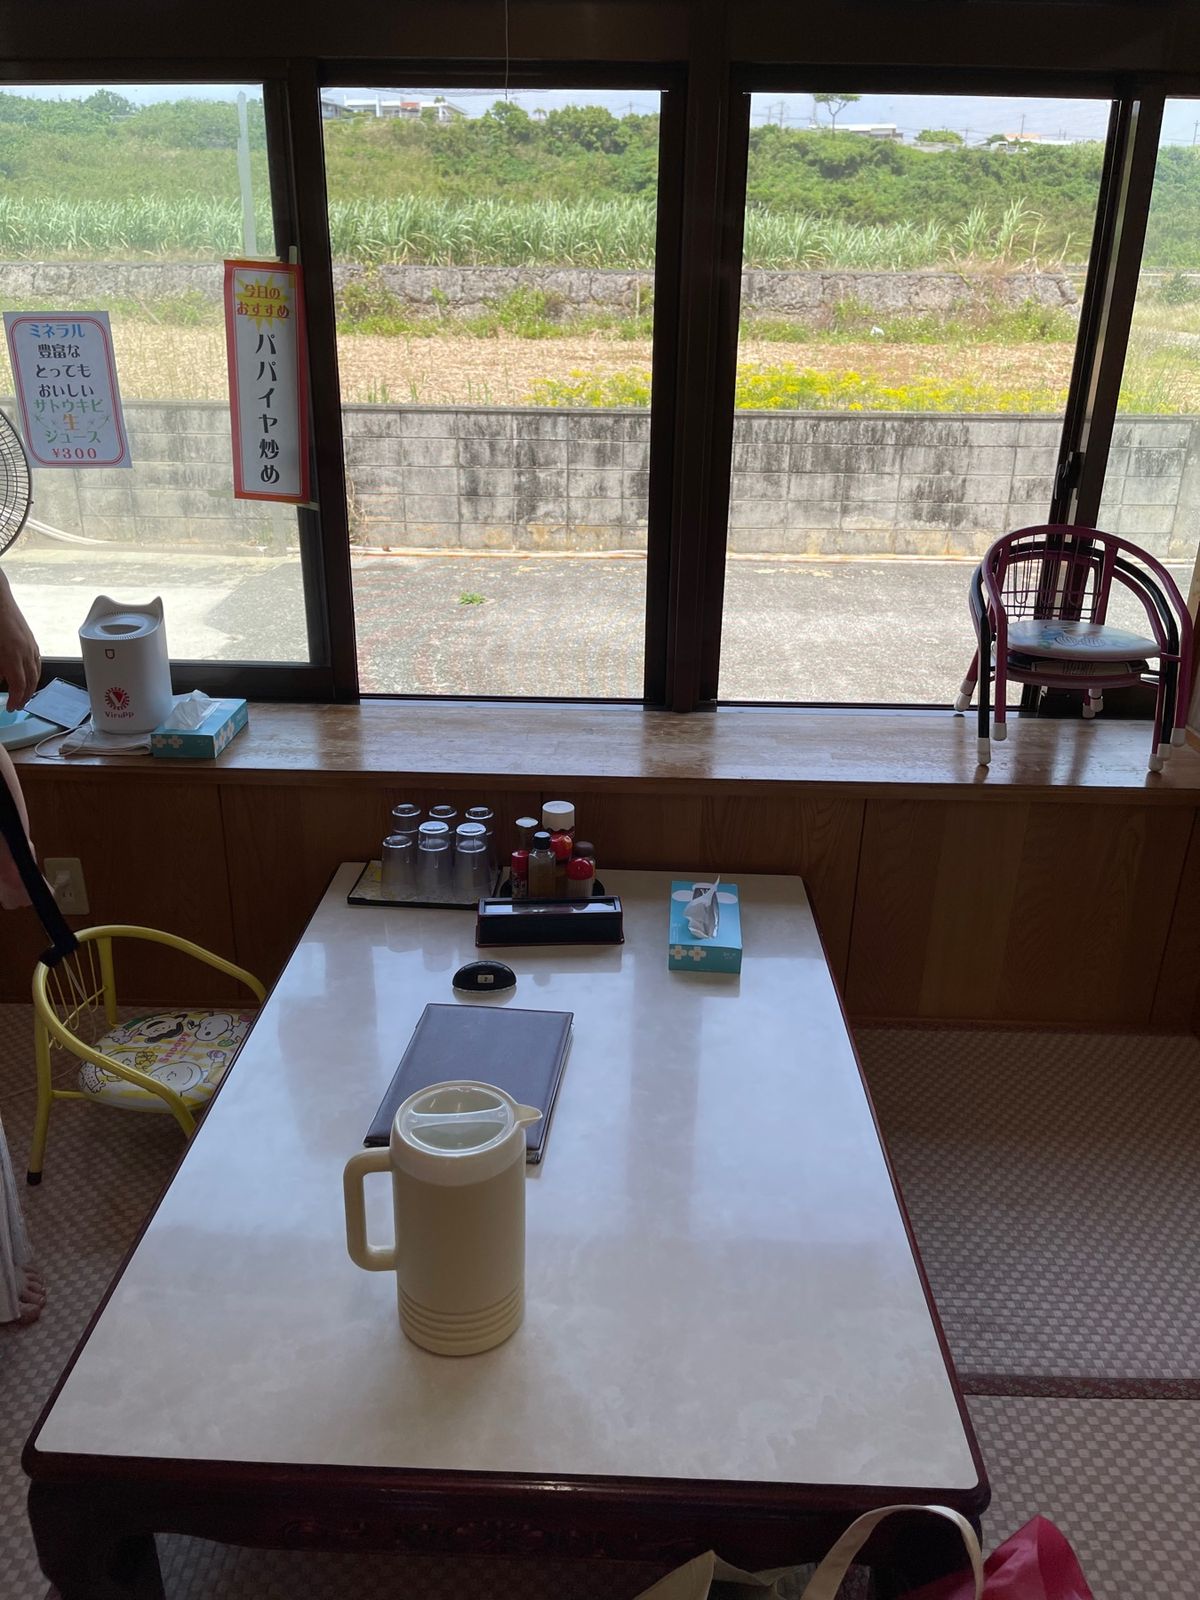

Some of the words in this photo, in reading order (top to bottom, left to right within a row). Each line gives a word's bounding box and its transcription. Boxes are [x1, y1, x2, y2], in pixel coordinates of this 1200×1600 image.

[244, 284, 281, 299] 今日の
[237, 302, 290, 318] おすすめ
[29, 324, 85, 338] ミネラル
[38, 344, 81, 359] 豊富な
[36, 364, 92, 378] とっても
[39, 383, 94, 398] おいしい
[34, 399, 104, 413] サトウキビ
[255, 334, 280, 485] パパイヤ炒め
[64, 413, 78, 431] 生
[46, 431, 101, 444] ジュース
[52, 448, 97, 459] ¥300
